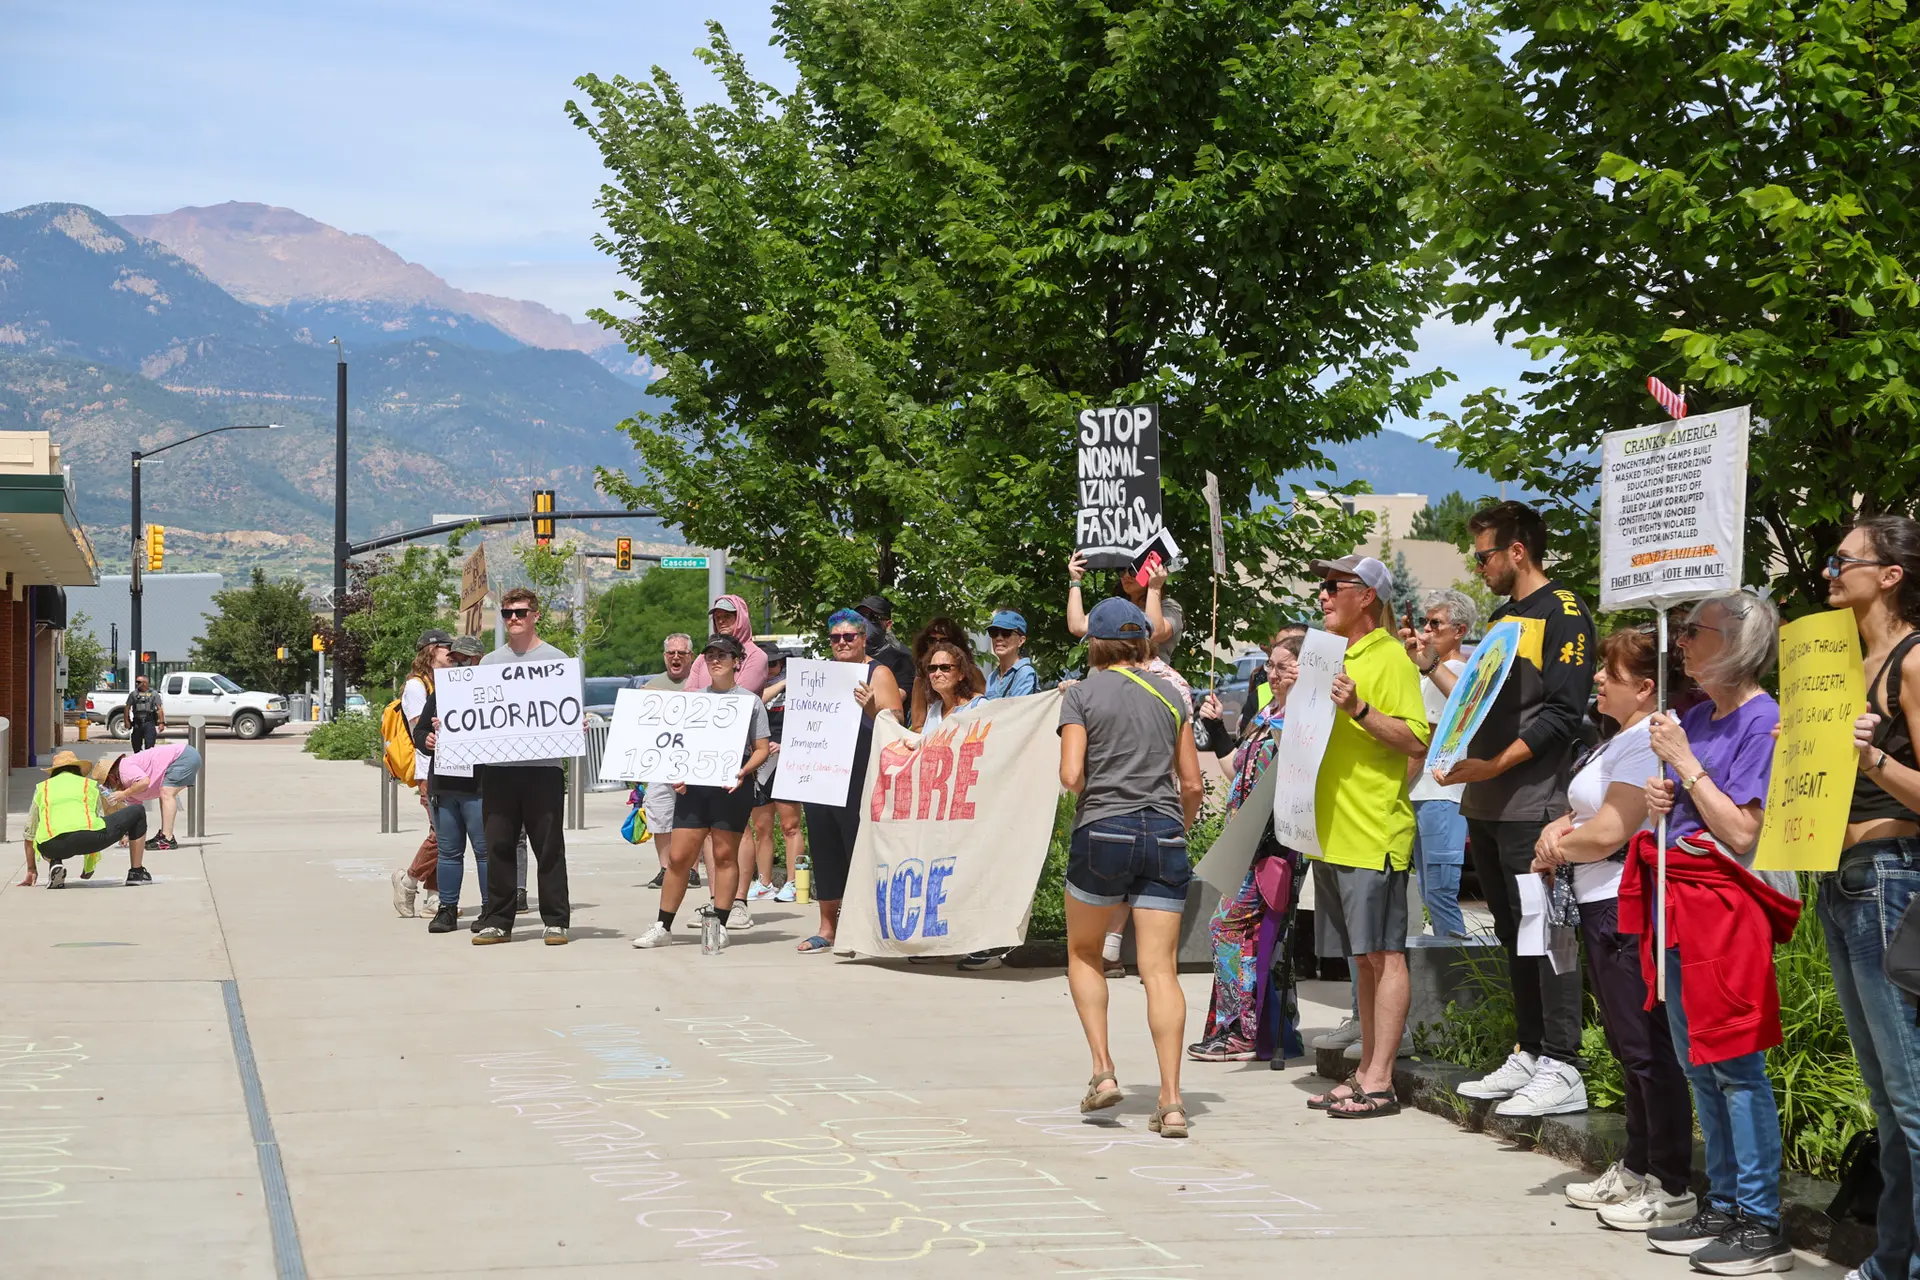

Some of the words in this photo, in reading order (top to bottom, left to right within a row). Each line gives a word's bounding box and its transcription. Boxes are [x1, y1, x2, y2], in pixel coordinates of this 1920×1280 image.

[1080, 407, 1152, 446] STOP
[1670, 423, 1718, 445] AMERICA
[1611, 454, 1666, 472] CONCENTRATION
[1667, 449, 1692, 461] CAMPS
[1693, 444, 1712, 455] BUILT
[1614, 470, 1642, 483] MASKED
[1643, 465, 1665, 477] THUGS
[1666, 456, 1712, 471] TERRORIZING
[1621, 488, 1664, 503] BILLIONAIRES
[1665, 483, 1688, 493] PAYED
[1689, 480, 1702, 490] OFF
[1627, 477, 1664, 491] EDUCATION
[1666, 469, 1702, 483] DEFUNDED
[1080, 479, 1127, 508] IZING
[1622, 503, 1638, 514] RULE
[1638, 501, 1647, 511] OF
[1648, 499, 1663, 510] LAW
[1664, 492, 1705, 506] CORRUPTED
[1077, 496, 1162, 546] FASCISM
[1618, 510, 1663, 526] CONSTITUTION
[1664, 506, 1697, 519] IGNORED
[1622, 525, 1638, 536] CIVIL
[1638, 522, 1661, 533] RIGHTS
[1662, 517, 1697, 529] VIOLATED
[1632, 533, 1662, 546] DICTATOR
[1662, 529, 1699, 541] INSTALLED
[663, 558, 697, 567] Cascade
[1611, 574, 1631, 588] FIGHT
[1633, 571, 1654, 586] BACK!
[1662, 566, 1683, 580] VOTE
[1684, 564, 1701, 577] HIM
[1704, 563, 1725, 575] OUT!
[1574, 633, 1586, 666] vivo
[1814, 639, 1849, 653] THROUGH
[448, 668, 474, 682] NO
[502, 663, 565, 681] CAMPS
[800, 669, 827, 697] Fight
[473, 685, 505, 704] IN
[789, 699, 842, 714] IGNORANCE
[1309, 686, 1317, 708] A
[444, 696, 581, 733] COLORADO
[638, 694, 740, 729] 2025
[1806, 706, 1835, 723] GROWS
[1839, 703, 1853, 722] UP
[806, 721, 823, 732] NOT
[655, 731, 684, 748] OR
[1802, 737, 1816, 756] AN
[620, 747, 739, 782] 1935?
[871, 717, 993, 822] FIRE
[875, 856, 957, 941] ICE
[662, 1014, 834, 1065] DEFEND
[455, 1050, 581, 1068] NO
[591, 1077, 788, 1119] DUE
[767, 1073, 922, 1107] THE
[485, 1073, 697, 1202] CONCENTRATION
[682, 1134, 986, 1261] PROCESS
[820, 1116, 1204, 1280] CONSTITUTI
